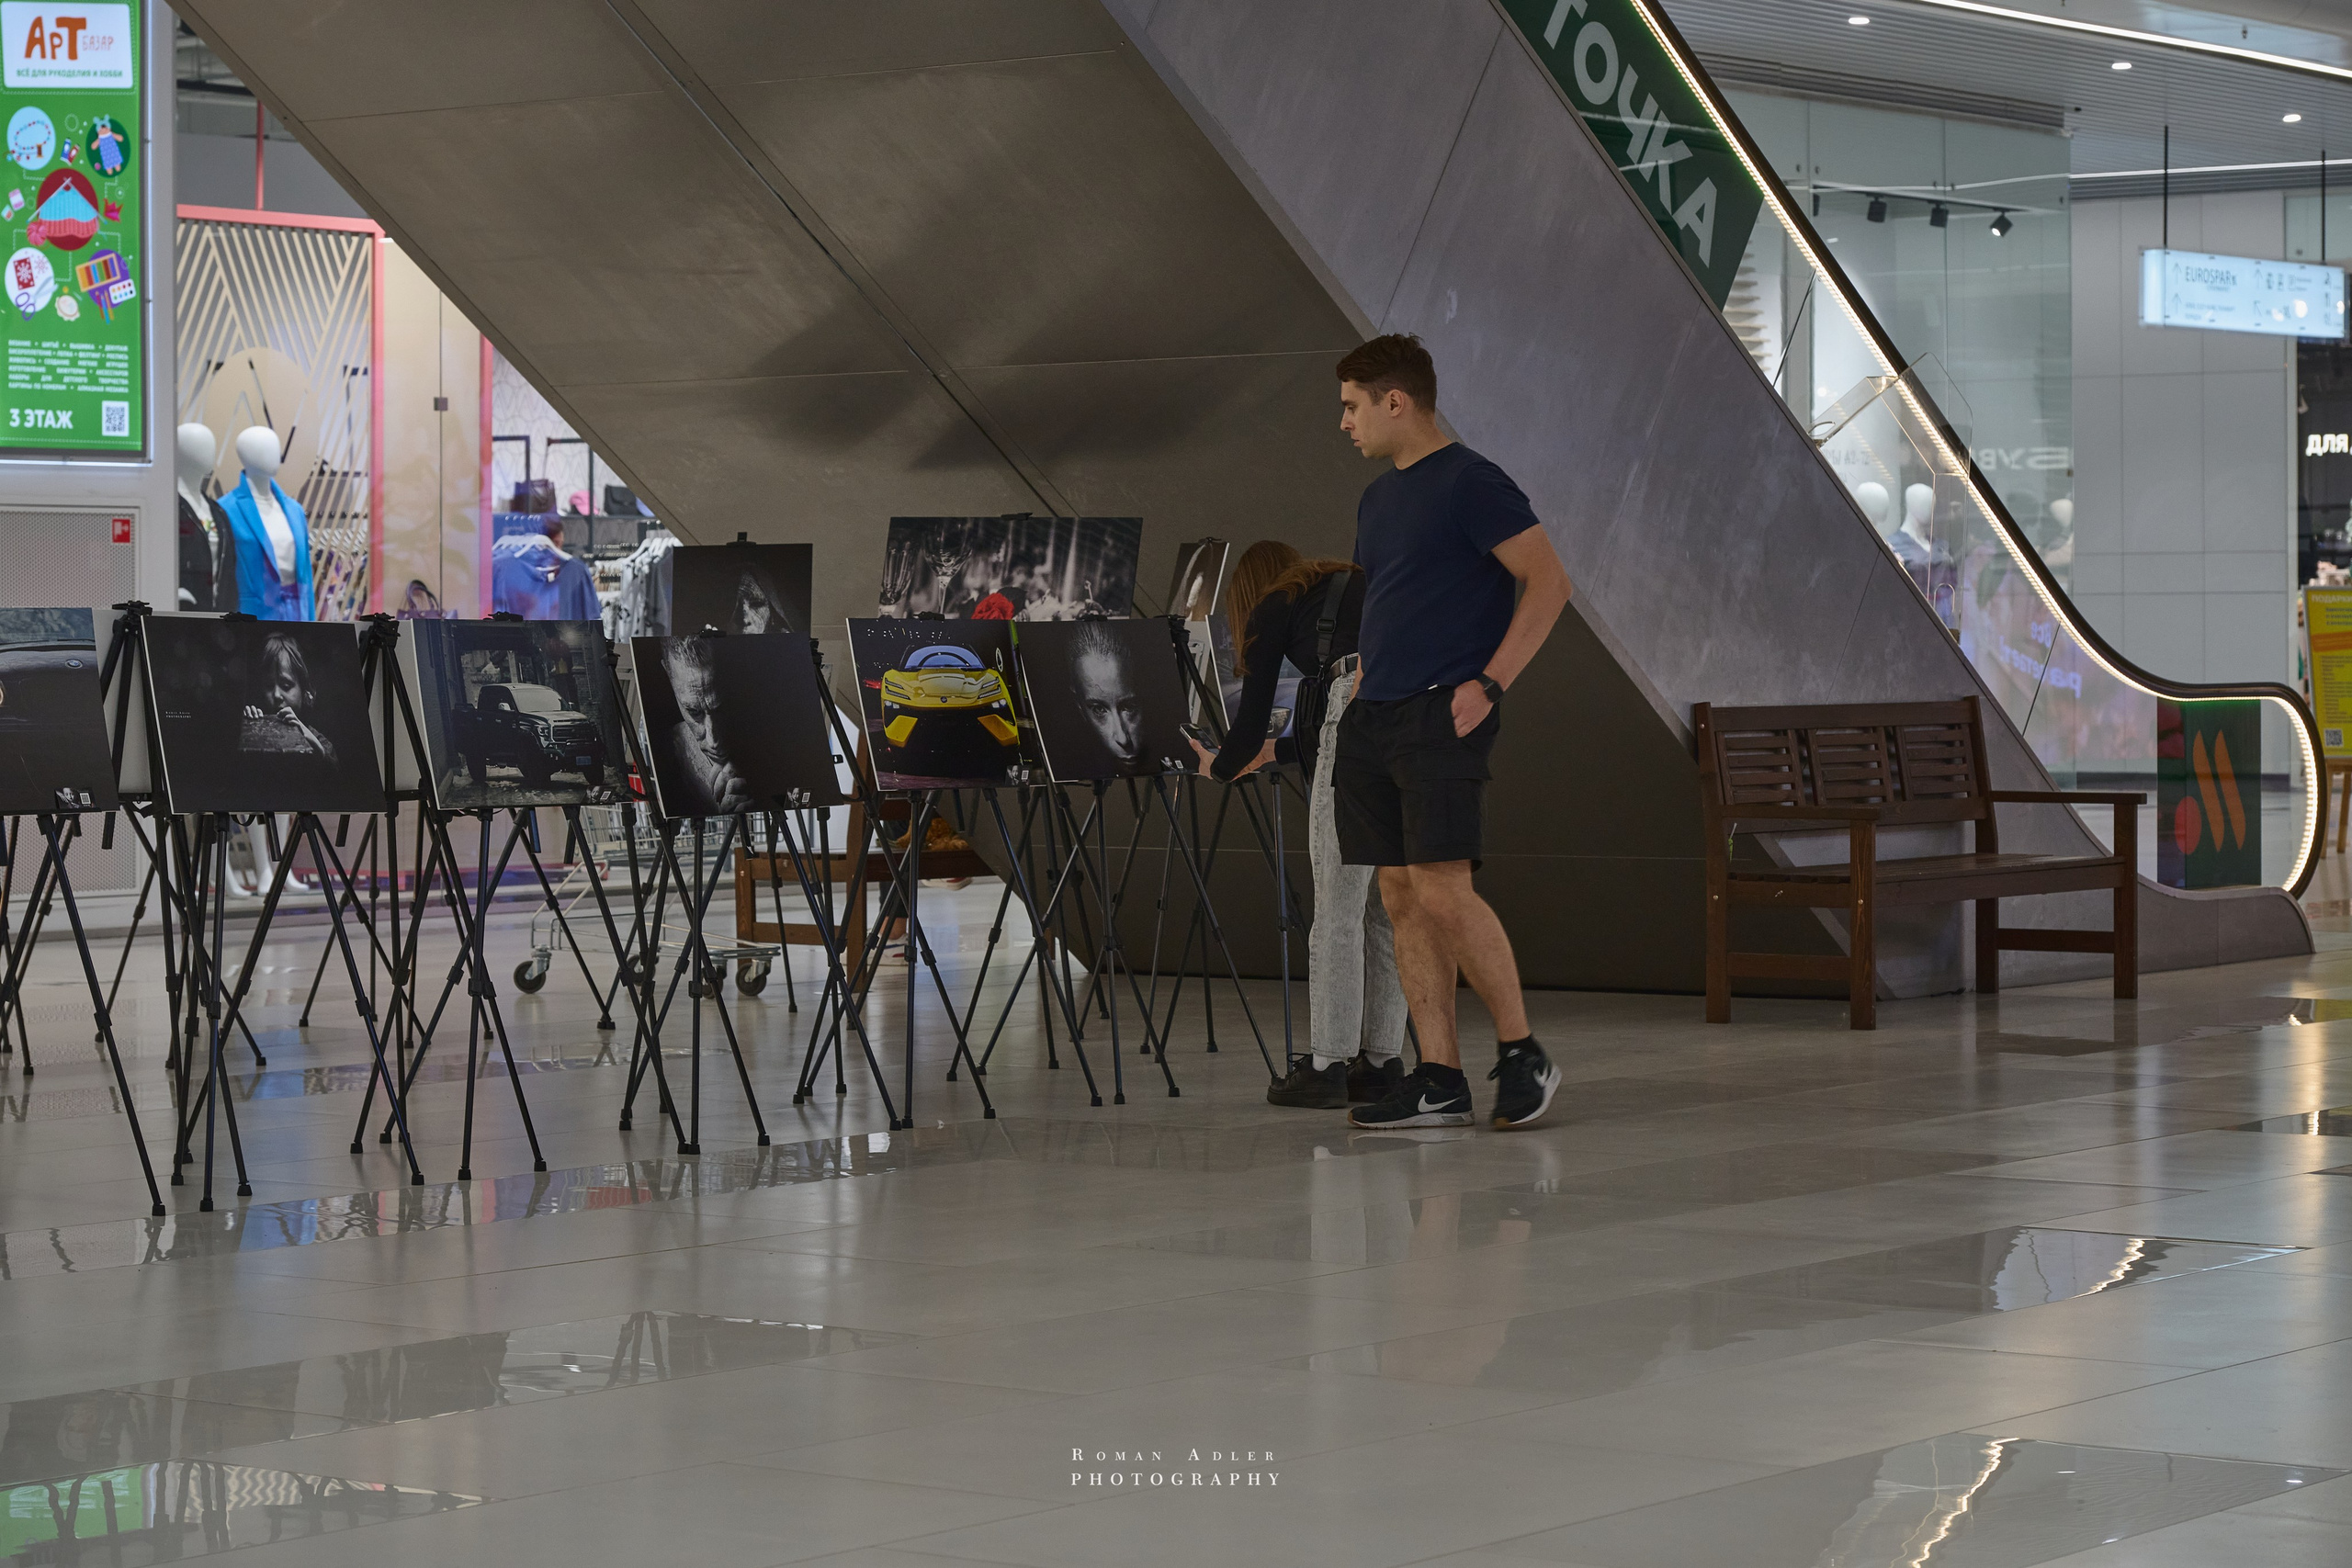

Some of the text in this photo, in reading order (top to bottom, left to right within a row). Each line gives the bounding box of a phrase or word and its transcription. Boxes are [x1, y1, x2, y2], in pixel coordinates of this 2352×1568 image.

[9, 408, 74, 429] 3 ЭТАЖ
[2305, 434, 2348, 457] ДЛЯ
